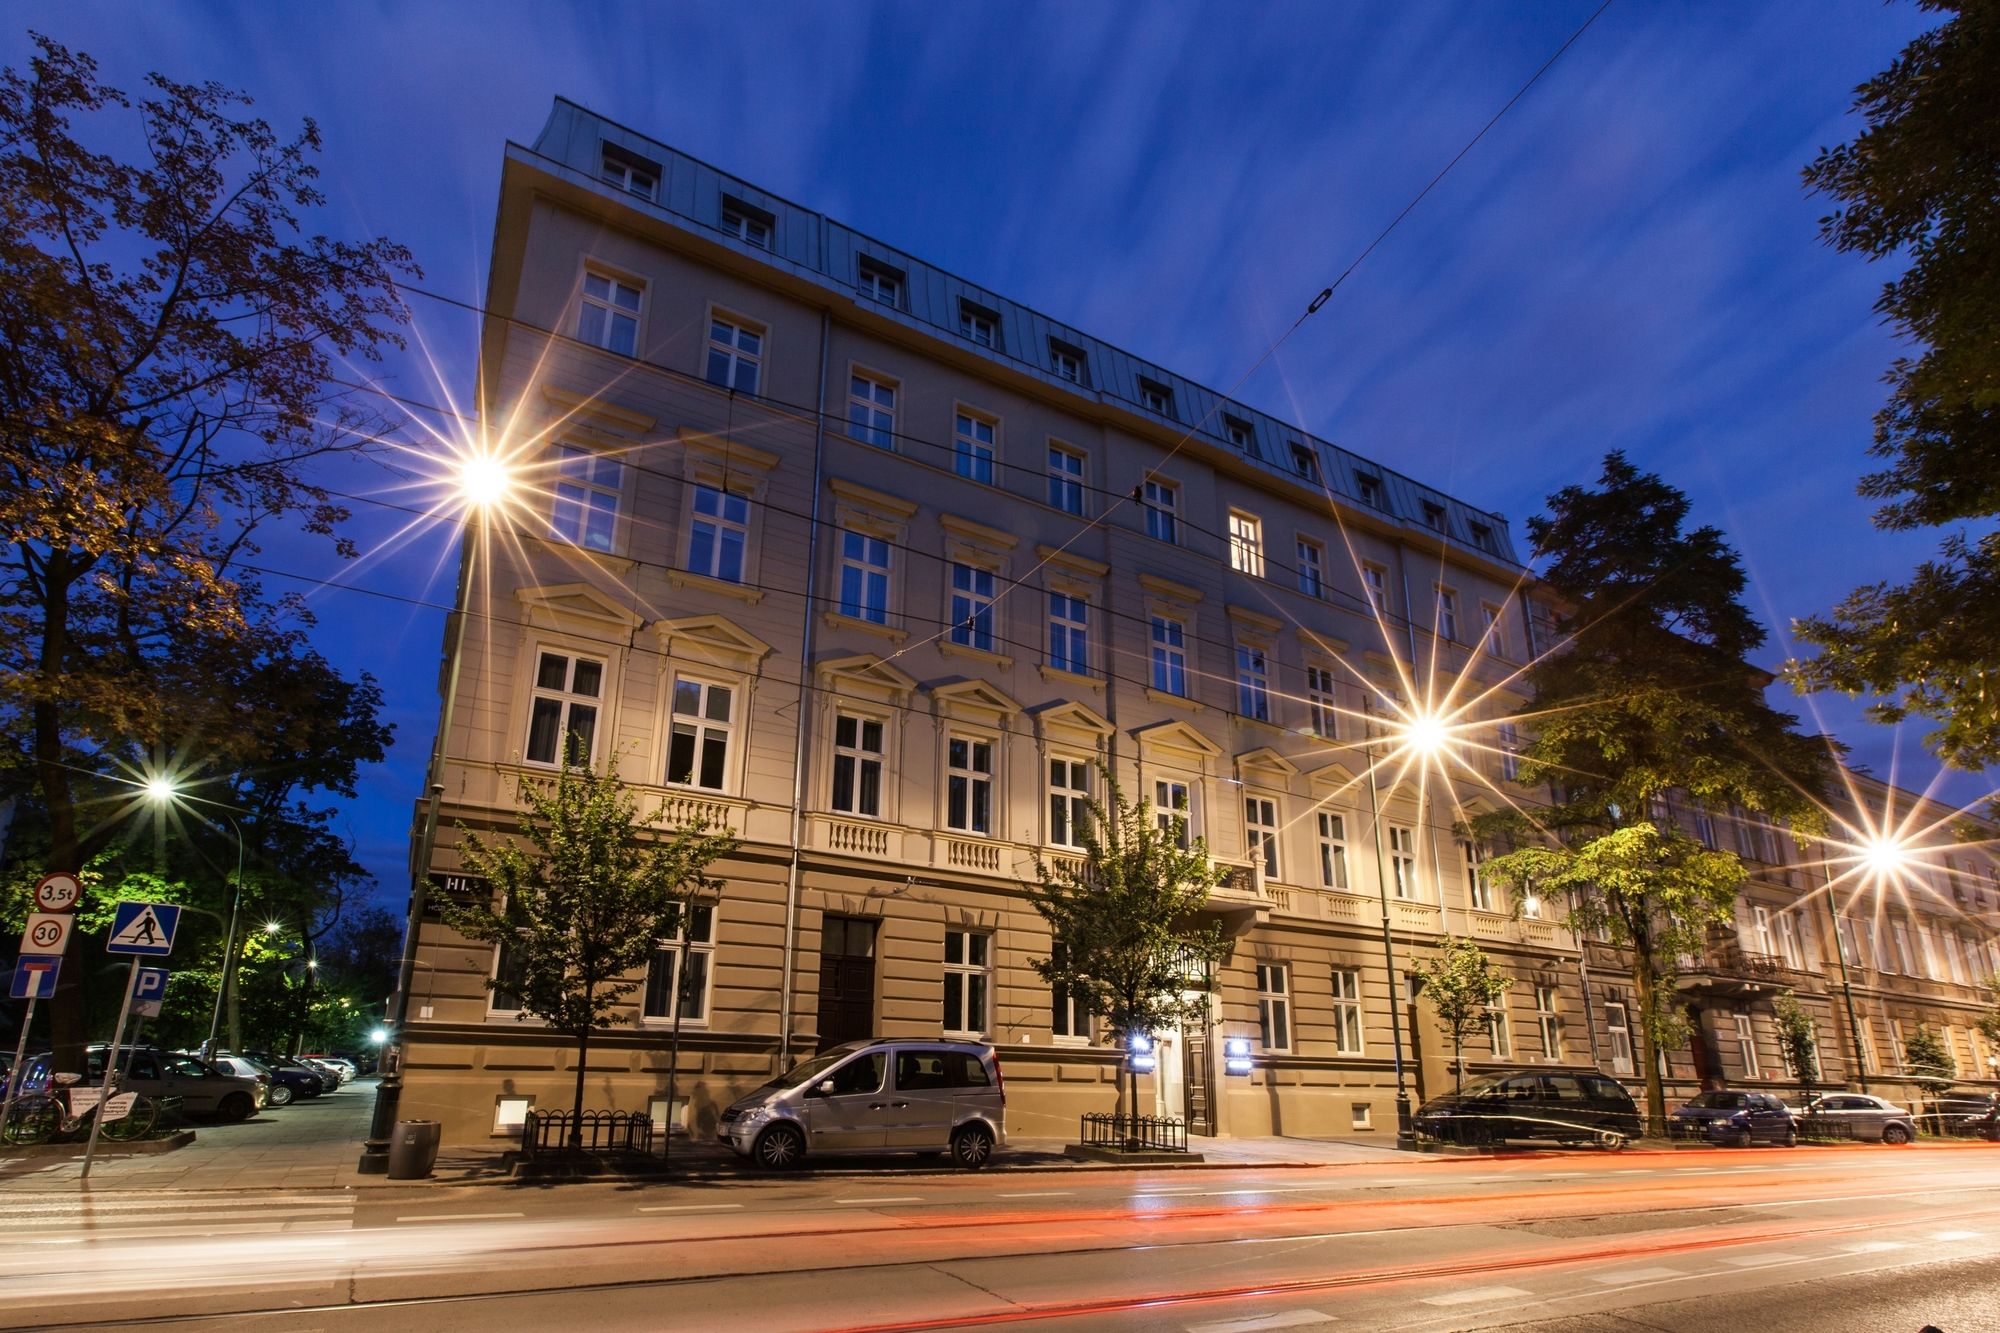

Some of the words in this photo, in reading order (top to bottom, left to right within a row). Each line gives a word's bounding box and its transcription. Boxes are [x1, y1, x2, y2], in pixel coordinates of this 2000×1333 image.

[41, 885, 73, 902] 3,5t
[35, 927, 59, 941] 30
[136, 971, 160, 997] P
